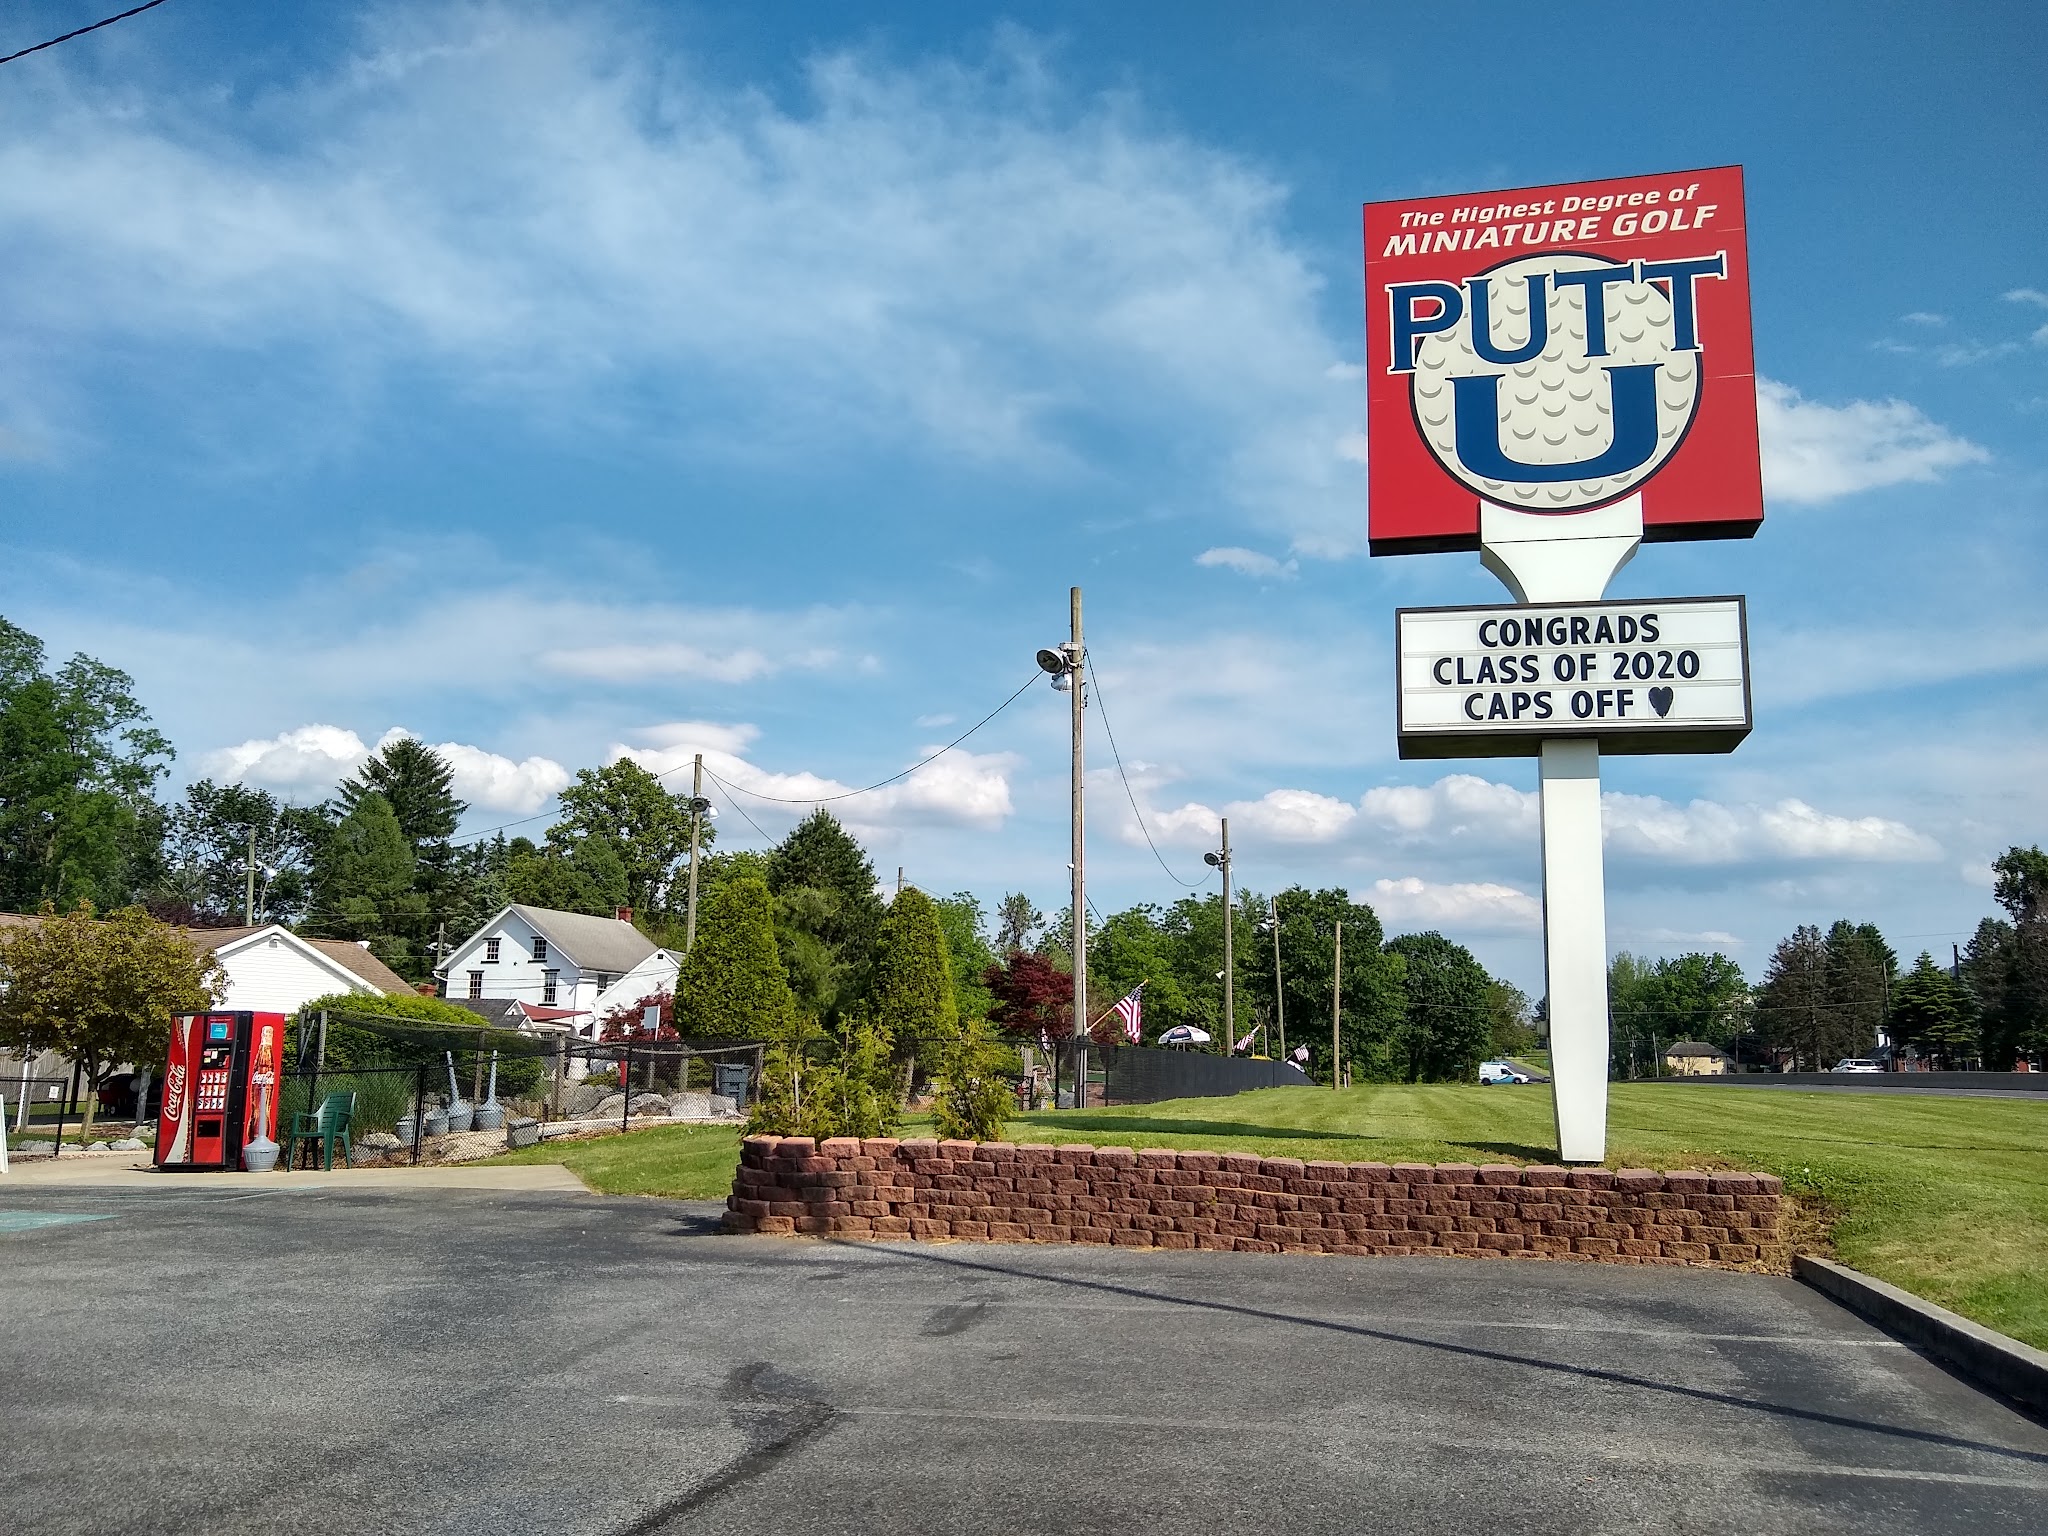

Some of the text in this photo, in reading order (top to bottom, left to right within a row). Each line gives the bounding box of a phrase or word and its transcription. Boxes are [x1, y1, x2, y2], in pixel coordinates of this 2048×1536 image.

[1399, 183, 1700, 228] The Highest Degree of
[1382, 204, 1718, 257] MINIATURE GOLF
[1387, 250, 1728, 375] PUTT
[1445, 363, 1665, 483] U
[1479, 614, 1660, 648] CONGRADS
[1433, 650, 1700, 685] CLASS OF 2020
[1464, 689, 1635, 721] CAPS OFF
